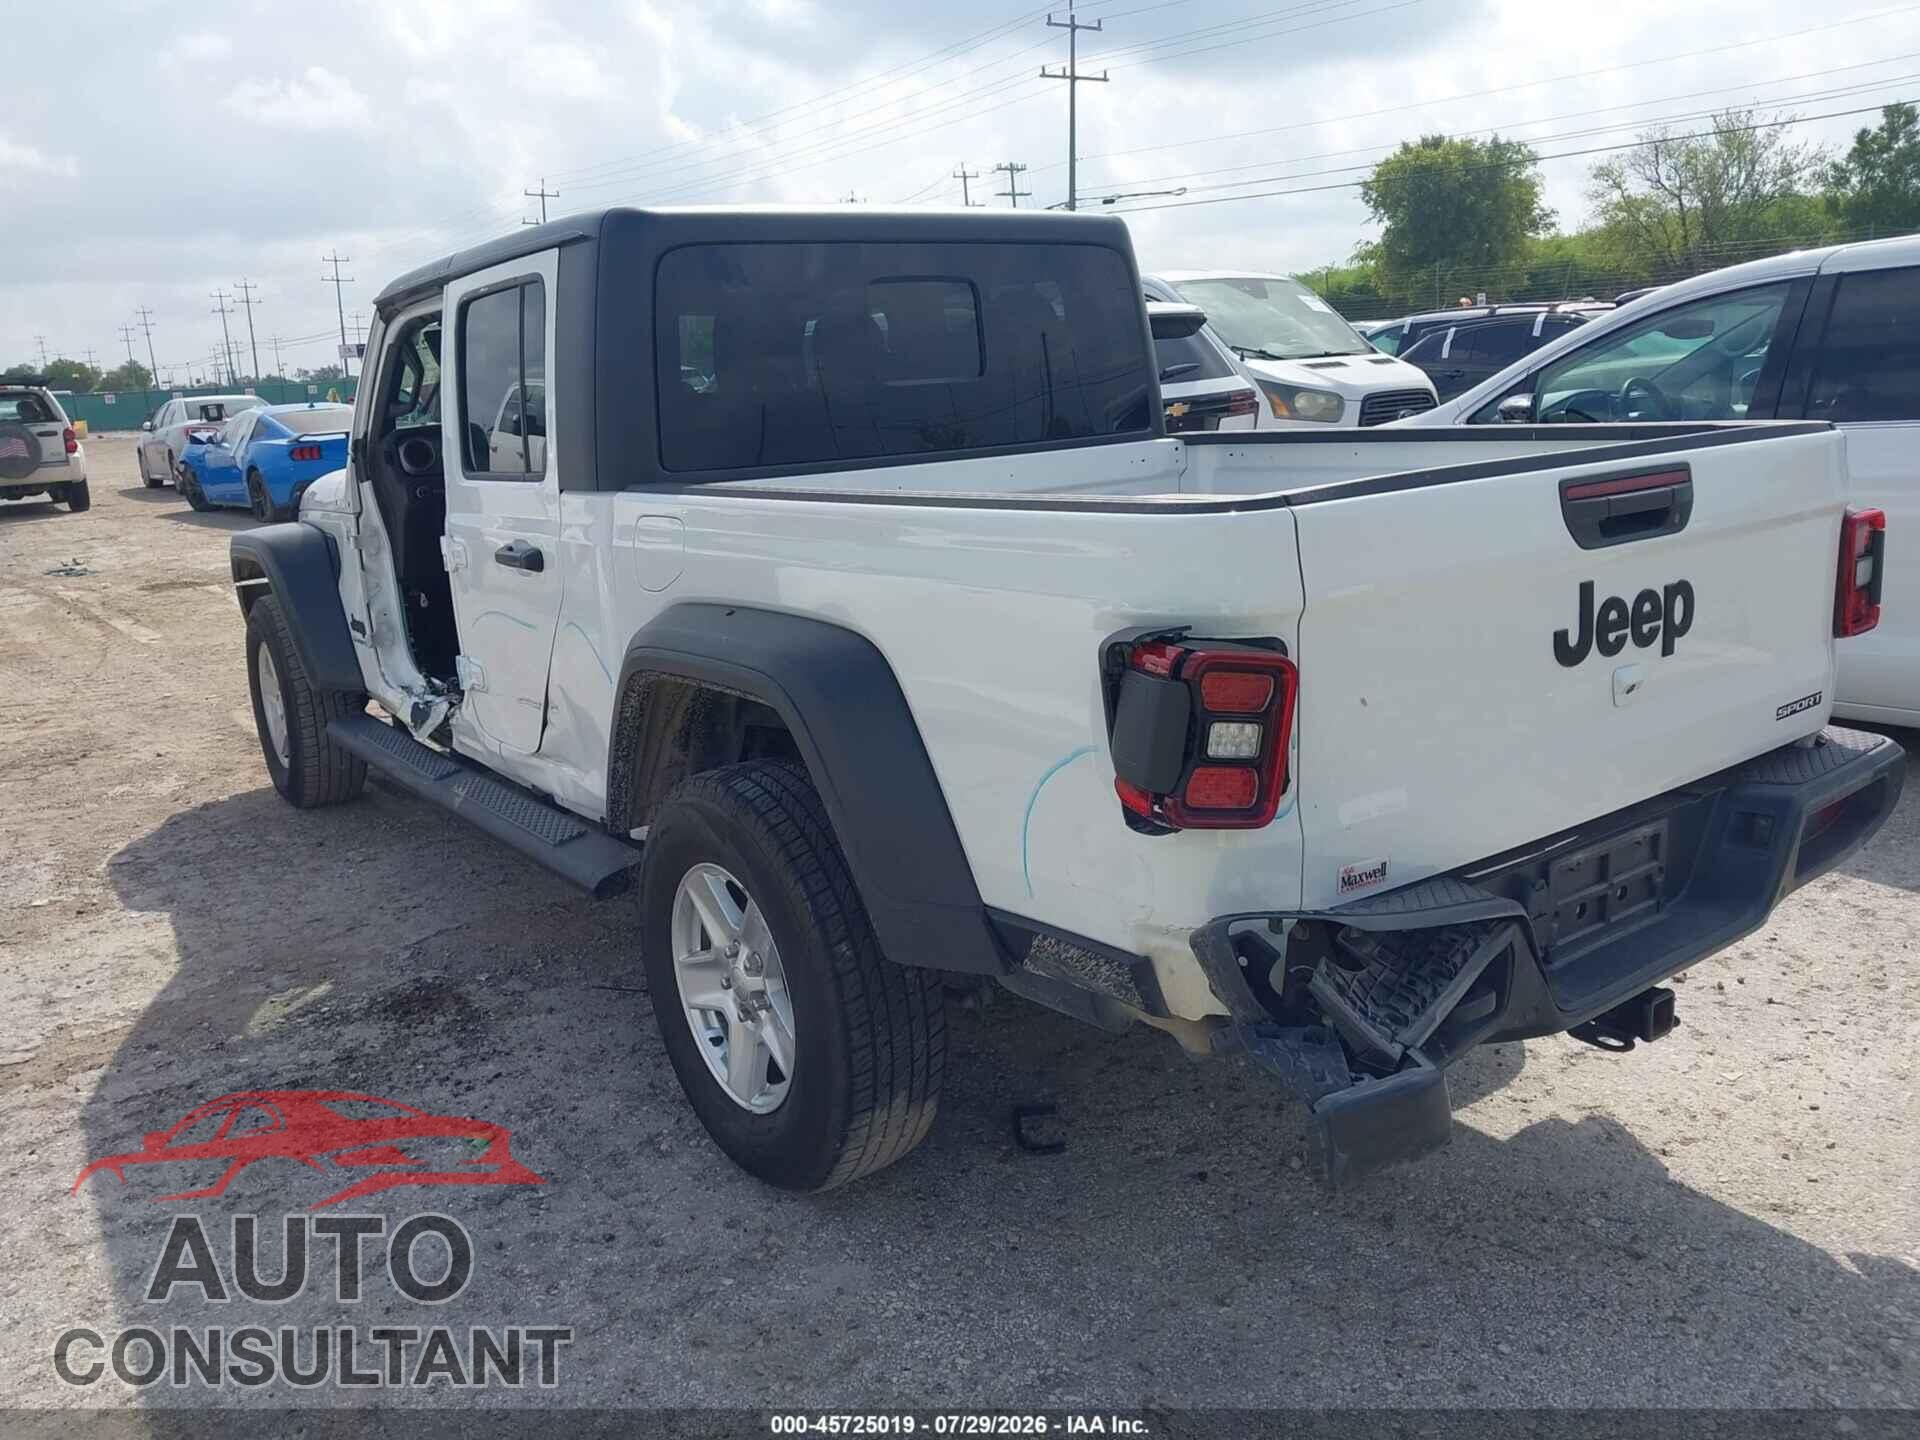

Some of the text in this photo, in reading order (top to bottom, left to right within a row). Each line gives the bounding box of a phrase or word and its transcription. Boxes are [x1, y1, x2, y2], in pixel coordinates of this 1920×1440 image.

[1553, 579, 1695, 667] Jeep
[1776, 693, 1822, 720] SPORT
[1341, 861, 1387, 889] Maxwell
